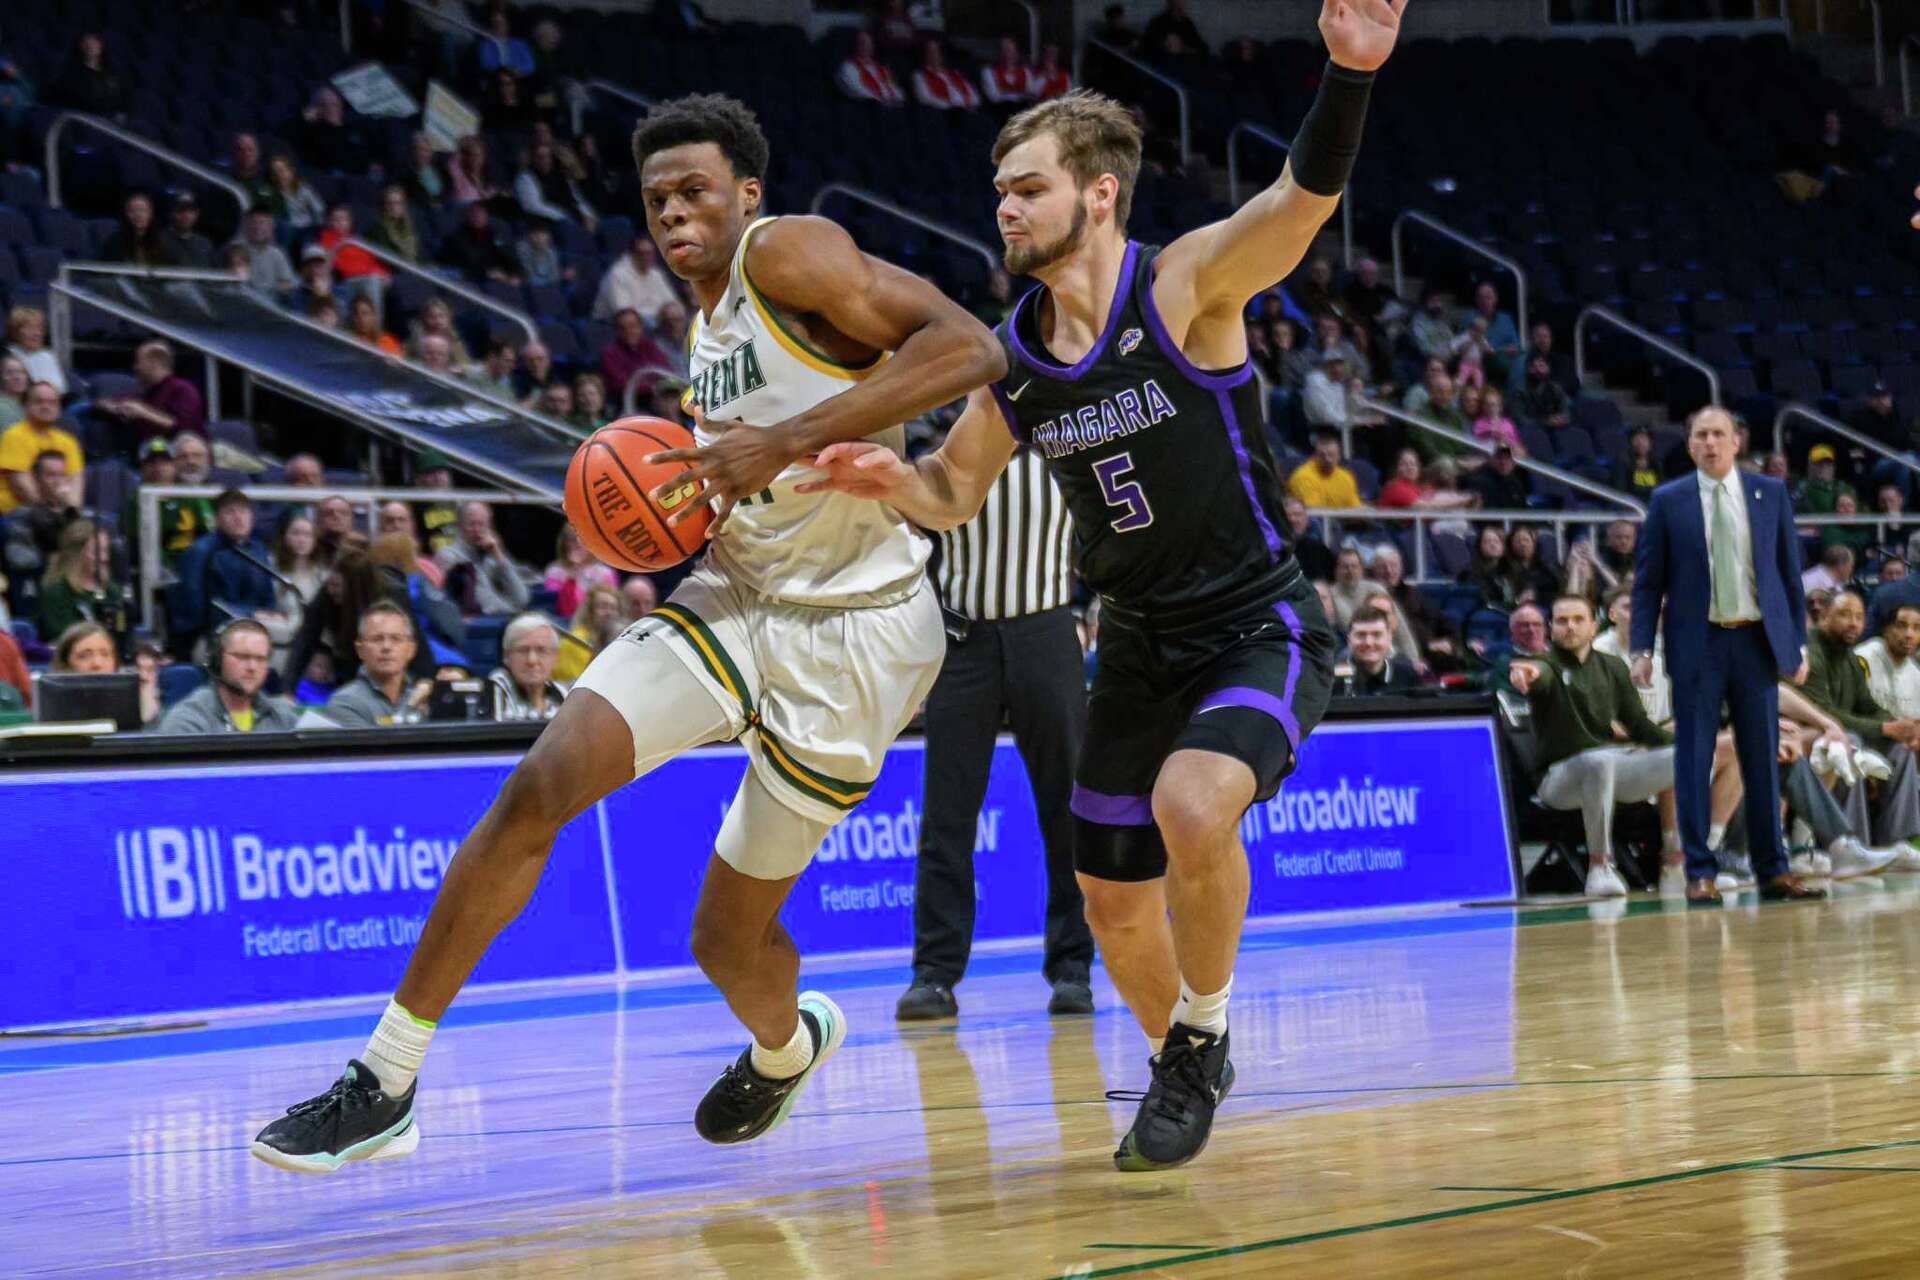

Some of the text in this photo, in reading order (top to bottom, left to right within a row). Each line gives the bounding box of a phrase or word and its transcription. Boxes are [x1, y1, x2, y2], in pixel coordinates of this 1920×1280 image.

[593, 472, 632, 521] THE
[1092, 452, 1153, 533] 5
[1267, 777, 1420, 833] Broadview
[1274, 848, 1402, 878] Federal Credit Union
[820, 880, 915, 912] Federal Cre
[243, 915, 427, 957] Federal Credit Uni
